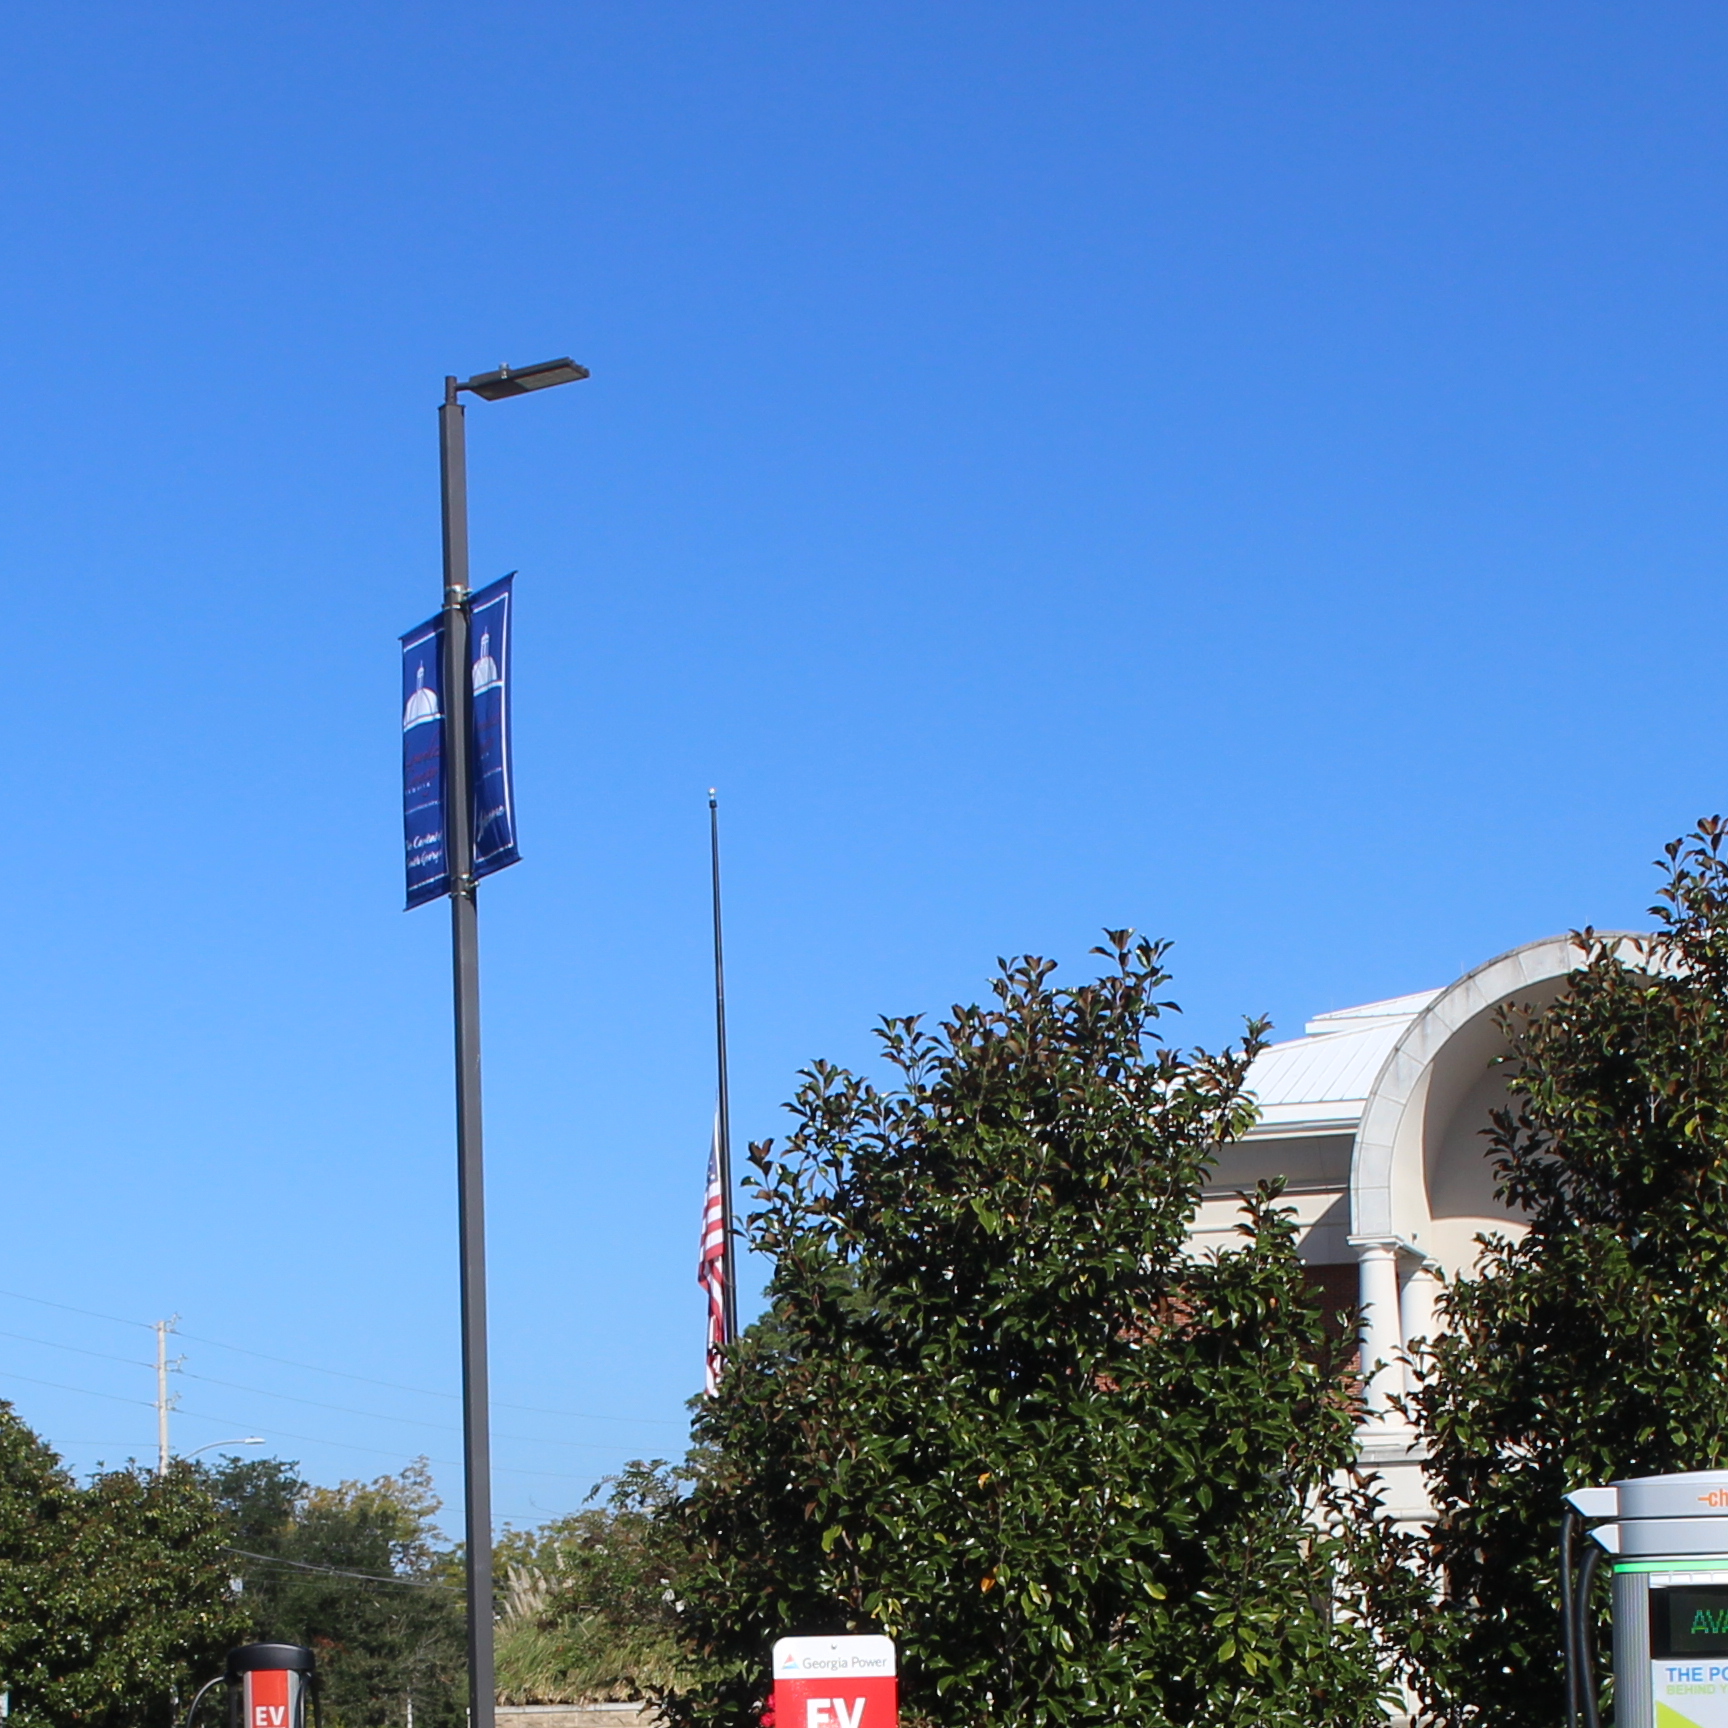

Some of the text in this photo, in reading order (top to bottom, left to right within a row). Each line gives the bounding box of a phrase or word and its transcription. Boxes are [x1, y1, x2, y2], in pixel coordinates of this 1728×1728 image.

[802, 1655, 887, 1671] Georgia Power
[1665, 1667, 1703, 1682] THE
[1666, 1683, 1716, 1695] BEHIND
[255, 1705, 286, 1726] EV
